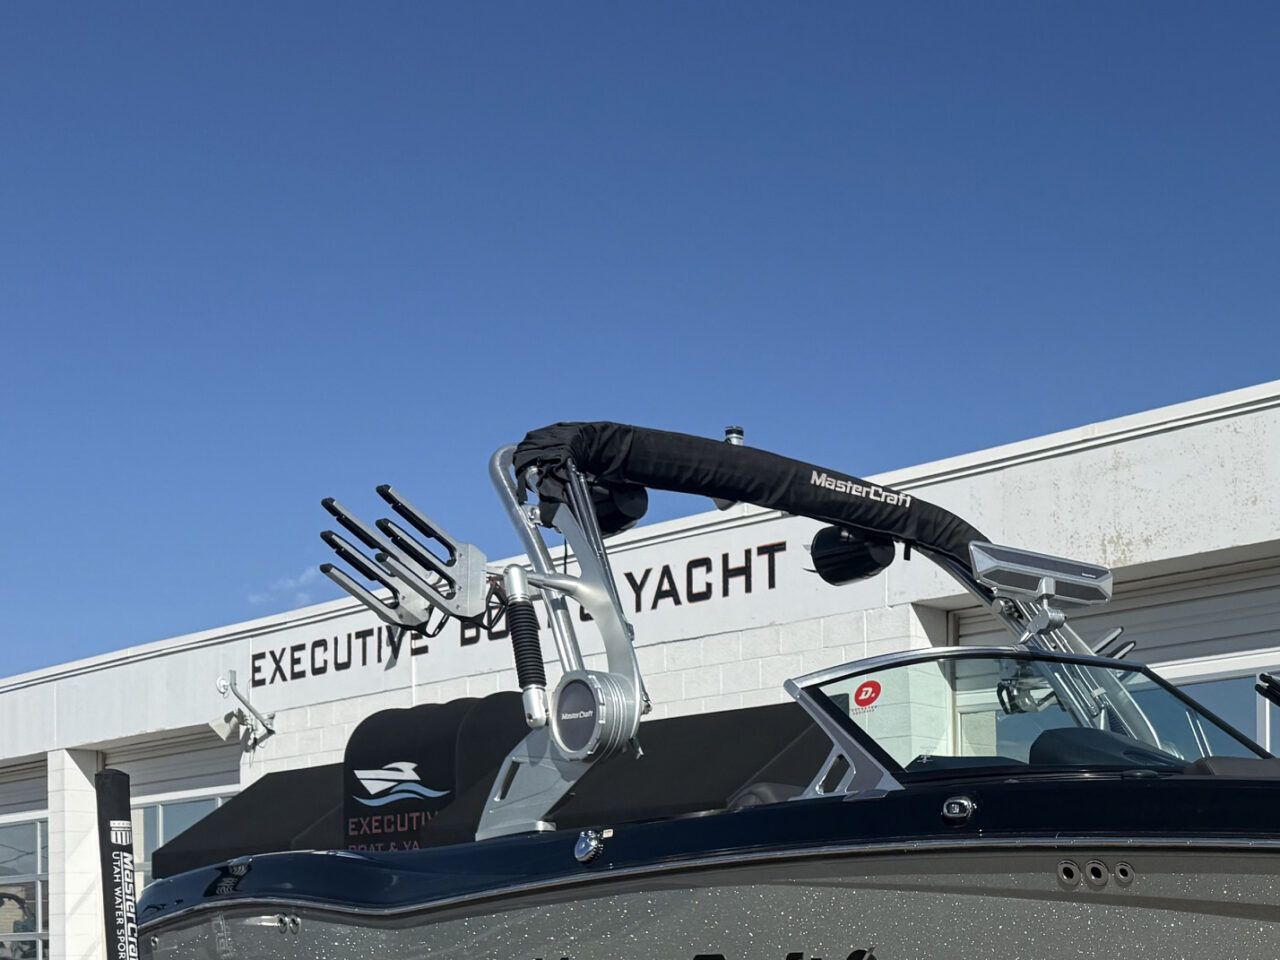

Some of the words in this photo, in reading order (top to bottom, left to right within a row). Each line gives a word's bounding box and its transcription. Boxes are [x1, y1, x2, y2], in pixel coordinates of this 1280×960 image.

[810, 470, 912, 508] MasterCraft
[624, 541, 787, 613] YACHT
[111, 851, 122, 883] UTAH
[114, 886, 124, 925] WATER
